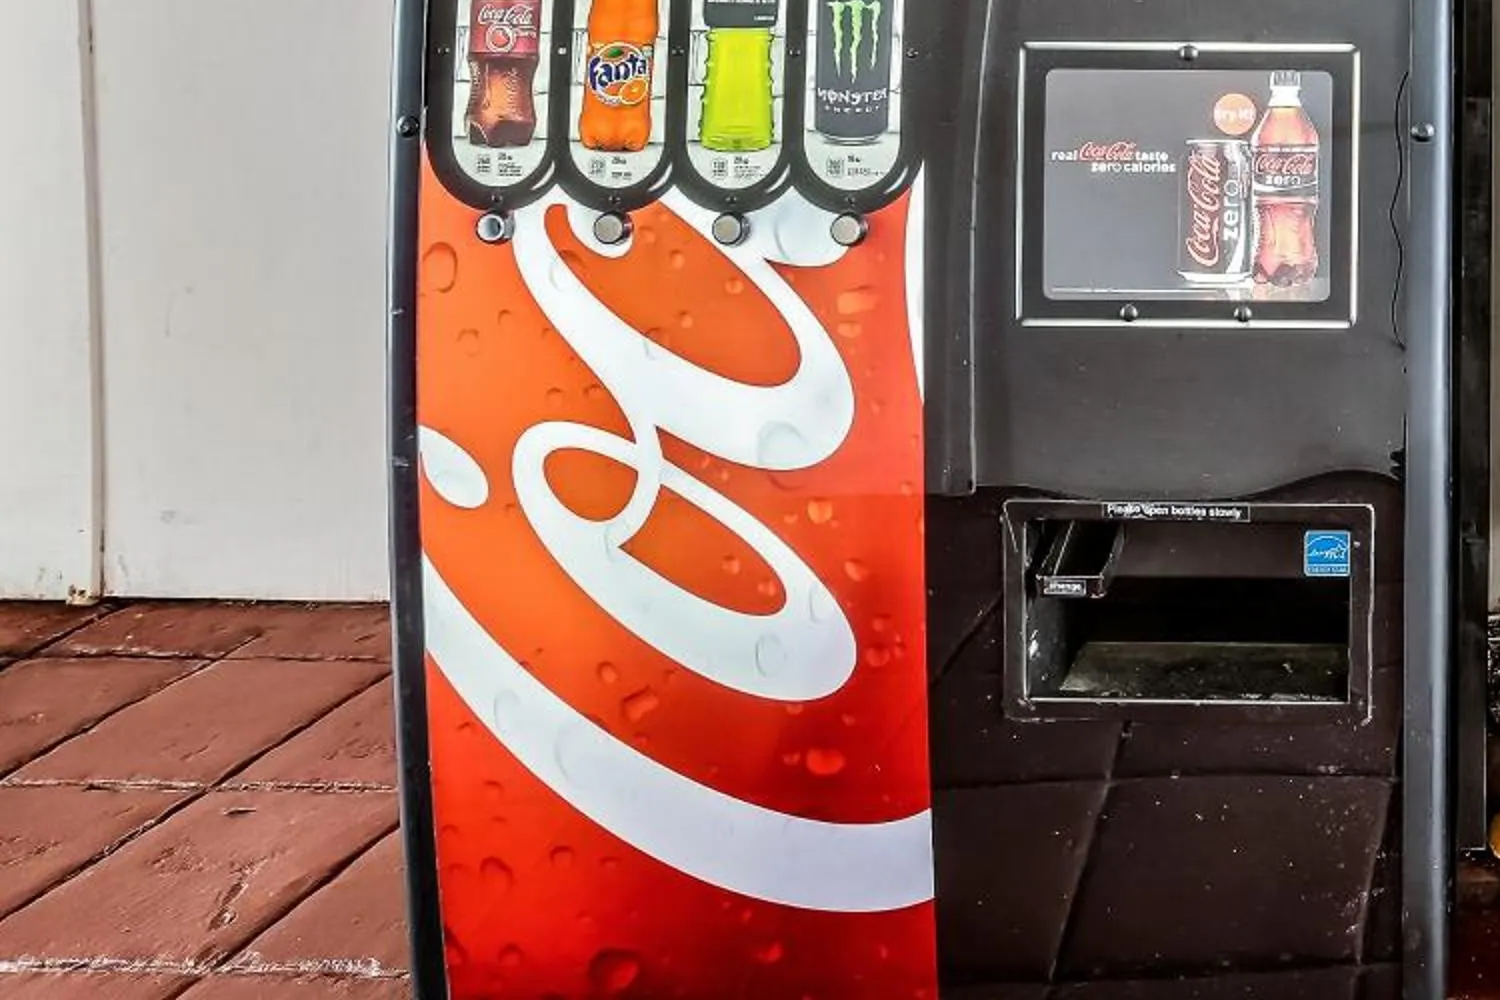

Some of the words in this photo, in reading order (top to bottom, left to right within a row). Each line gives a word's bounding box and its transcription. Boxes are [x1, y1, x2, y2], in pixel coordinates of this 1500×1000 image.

[478, 3, 535, 25] Coca-Cola
[817, 86, 888, 105] MONSTER
[1051, 149, 1078, 161] real
[1080, 141, 1137, 161] Coca-Cola
[1136, 150, 1169, 161] taste
[1091, 162, 1122, 173] zero
[1123, 162, 1176, 173] calories
[1256, 153, 1315, 175] Coca-Cola
[1265, 174, 1301, 186] zero
[1186, 149, 1222, 267] Coca-Cola
[1223, 179, 1240, 241] zero
[1107, 502, 1141, 518] Please
[1146, 505, 1169, 517] open
[1171, 505, 1207, 516] bottles
[1209, 506, 1242, 519] slowly
